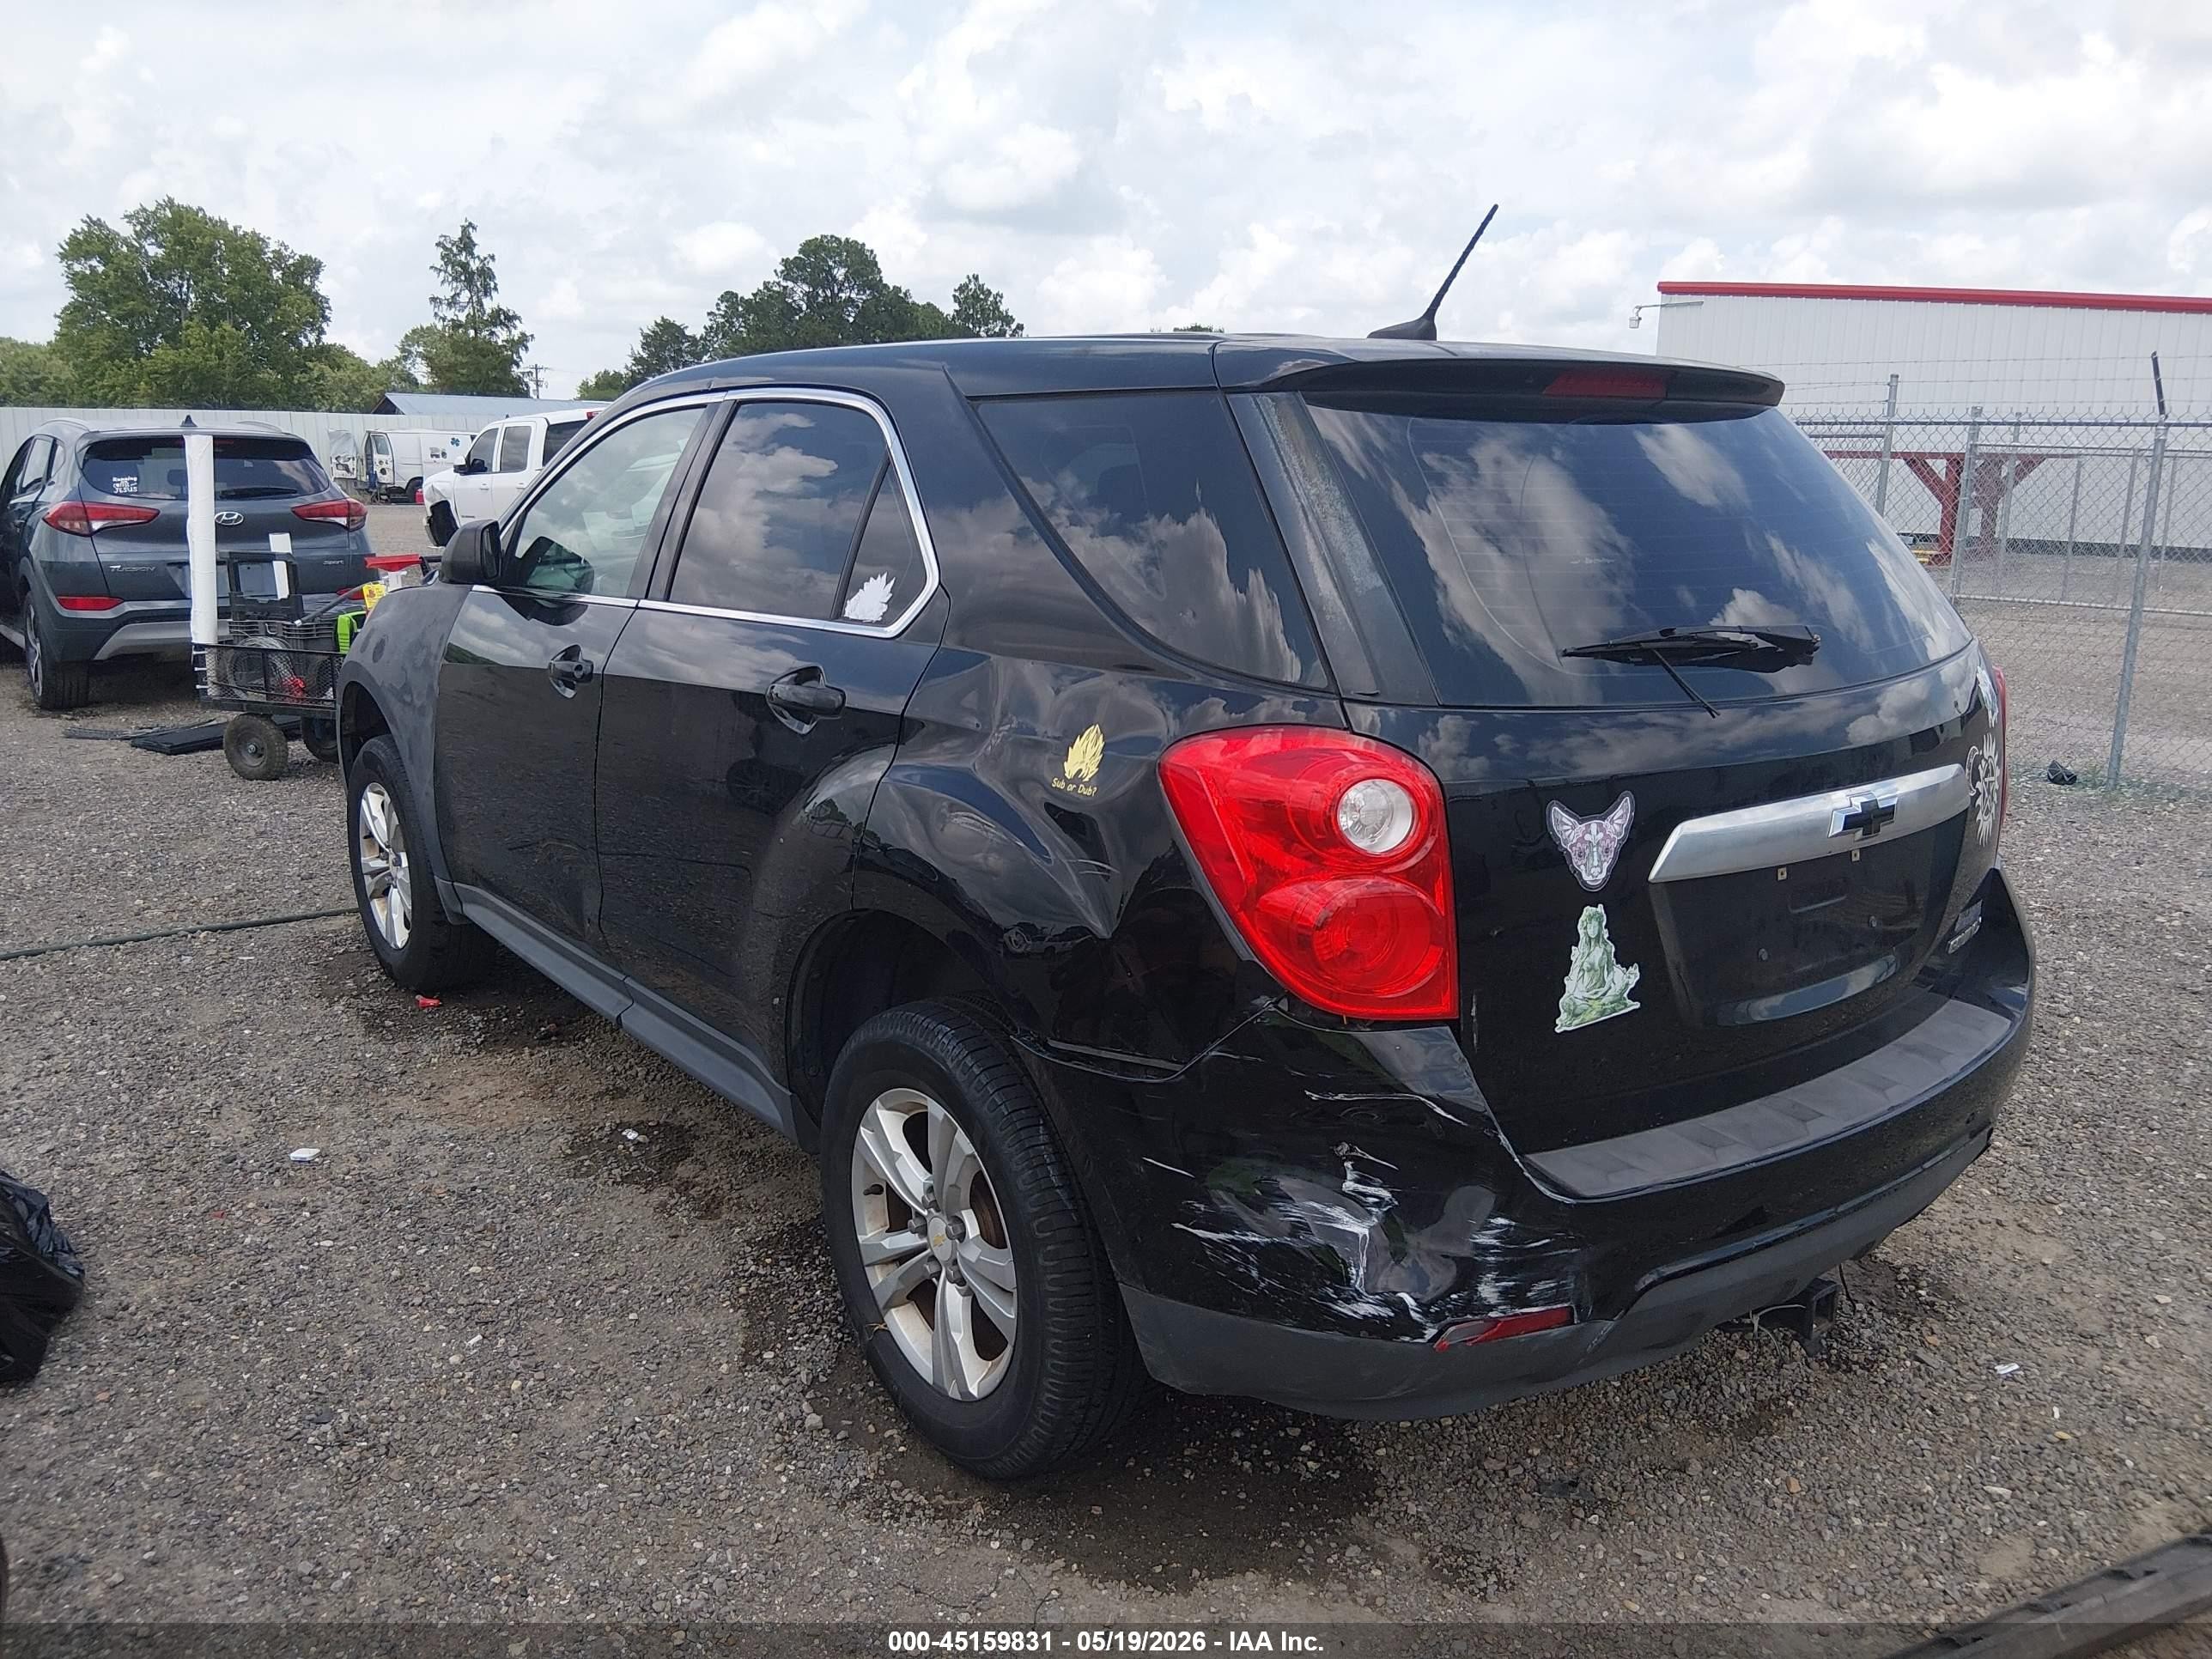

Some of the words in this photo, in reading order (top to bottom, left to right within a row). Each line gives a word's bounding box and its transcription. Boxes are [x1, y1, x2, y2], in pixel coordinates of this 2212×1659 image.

[1051, 777, 1066, 789] Sub
[1066, 783, 1077, 792] or
[1078, 784, 1097, 797] Dub?
